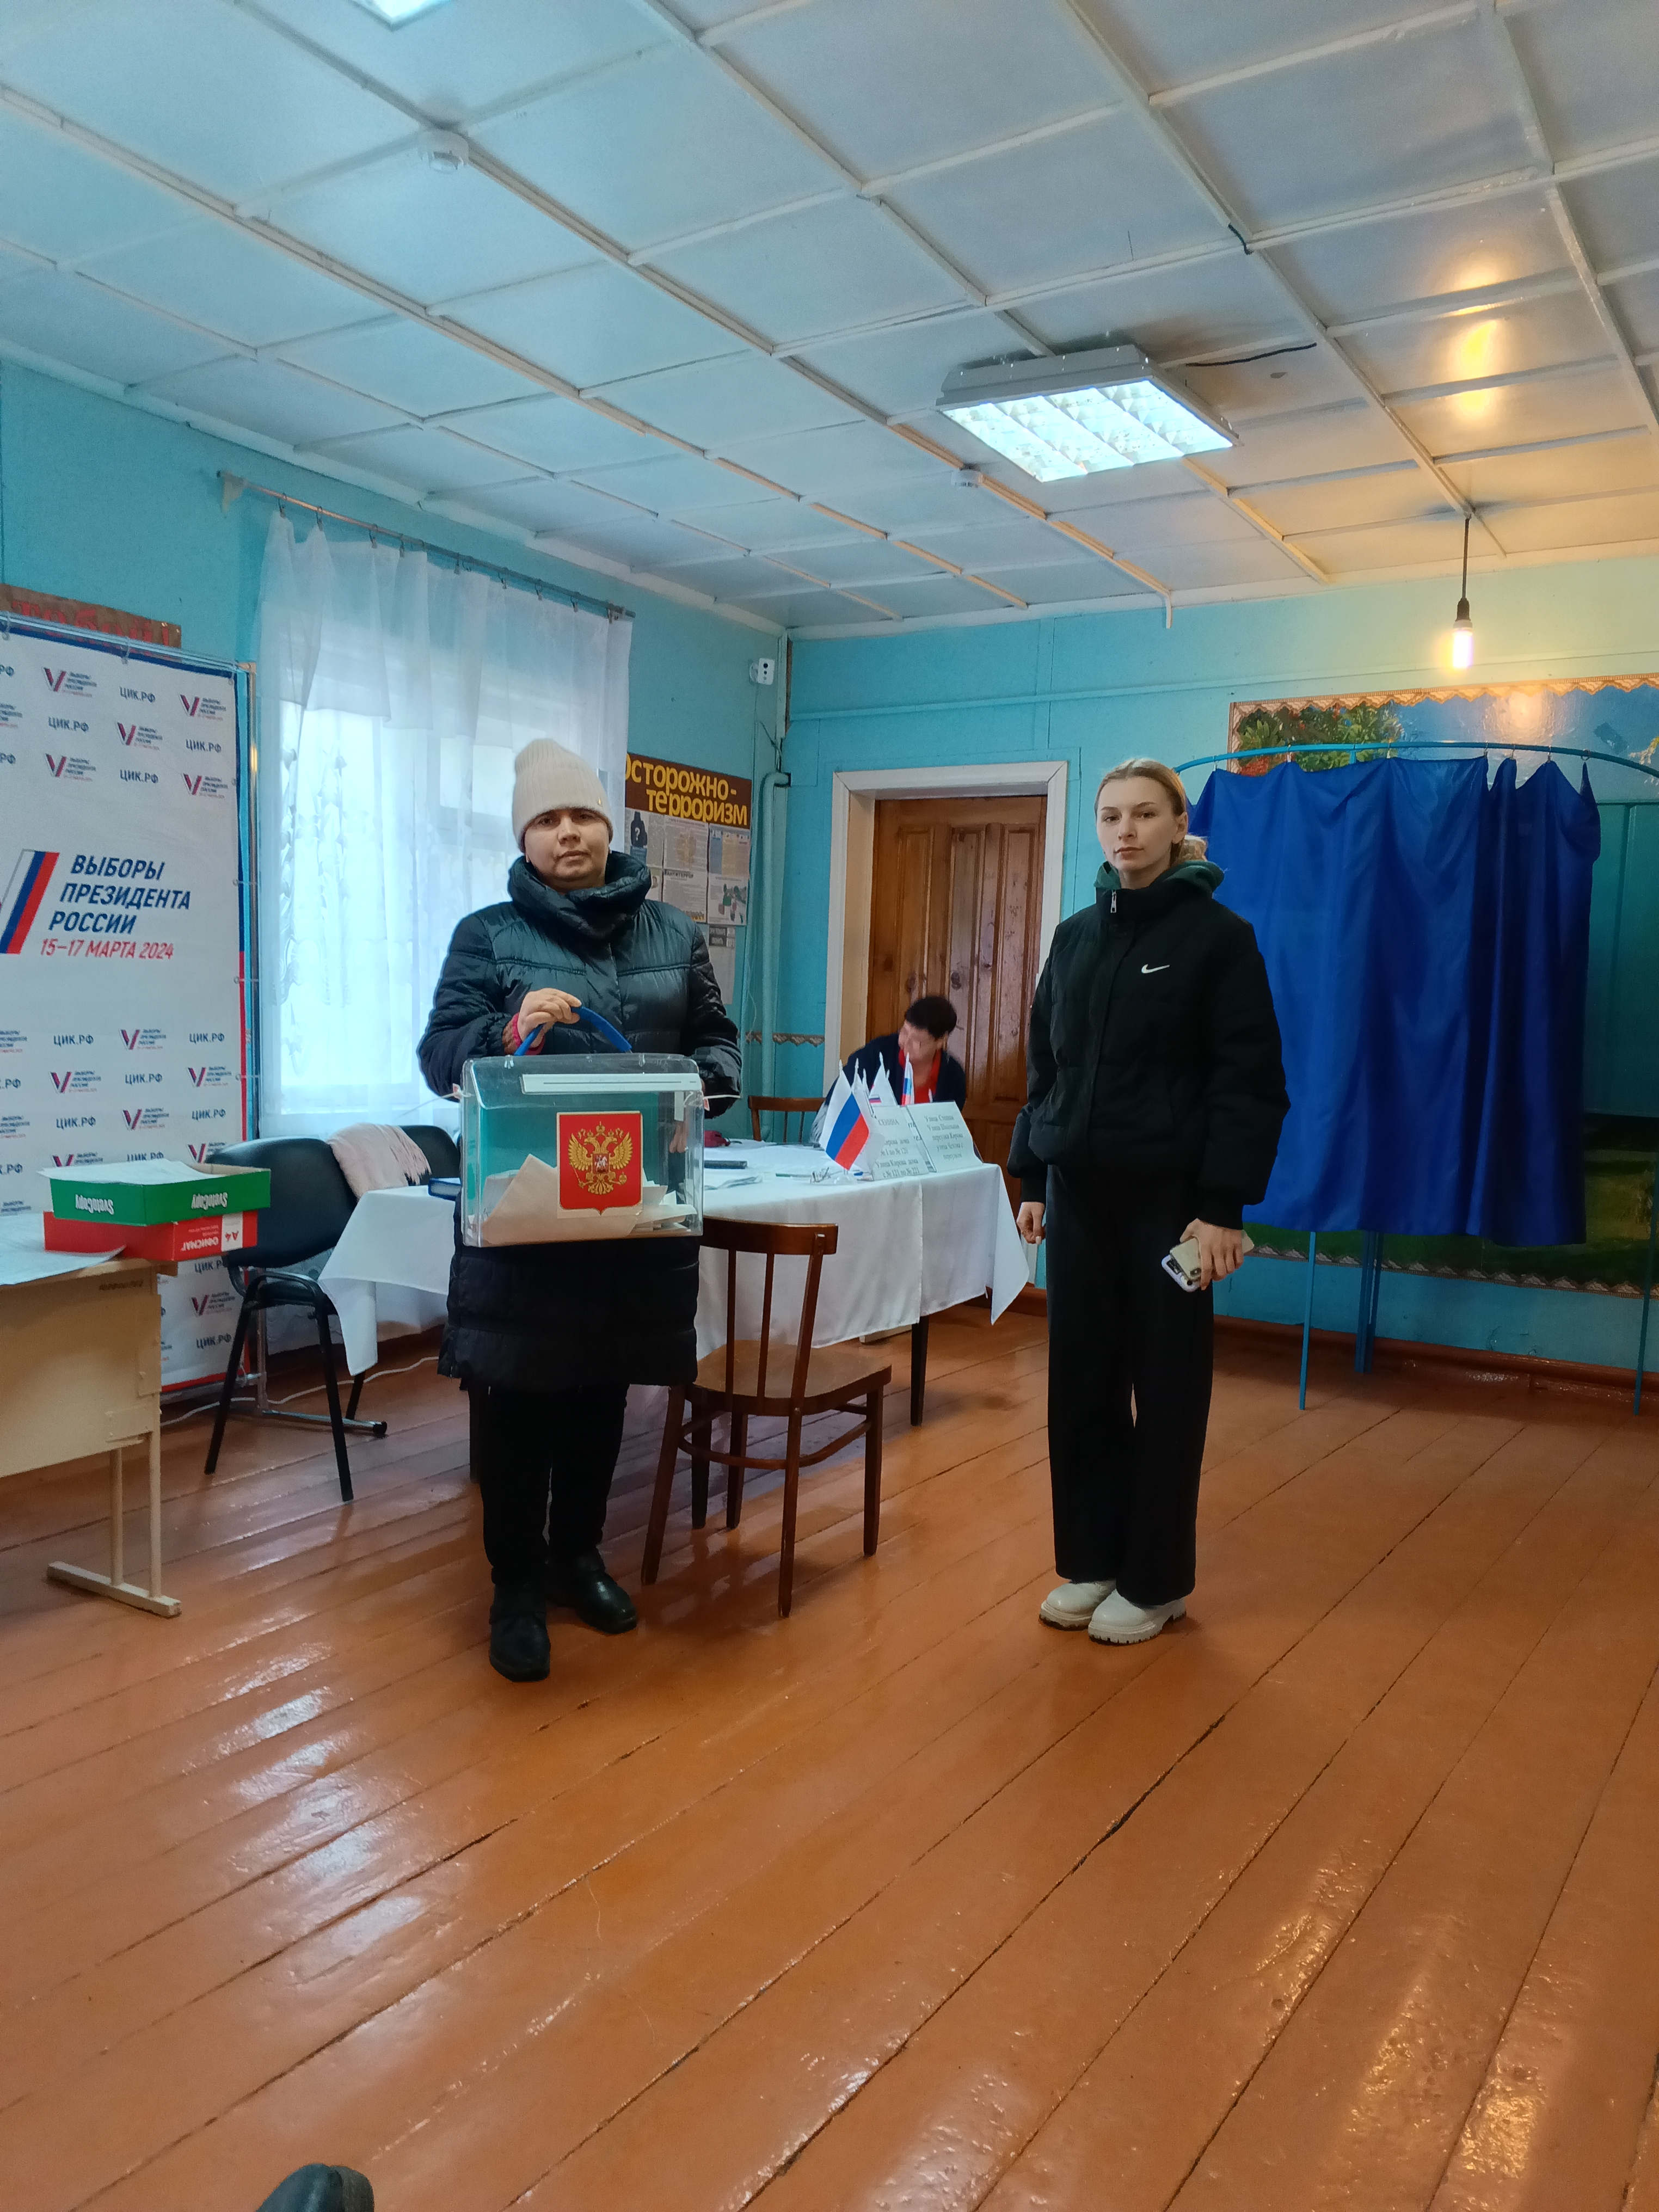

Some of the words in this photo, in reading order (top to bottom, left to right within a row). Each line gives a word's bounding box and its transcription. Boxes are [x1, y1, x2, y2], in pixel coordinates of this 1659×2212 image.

[120, 686, 156, 703] ЦИК.РФ
[48, 716, 89, 732] ЦИК.РФ
[186, 739, 222, 753] ЦИК.РФ
[120, 769, 158, 784] ЦИК.РФ
[646, 789, 747, 826] терроризм
[70, 854, 165, 881] ВЫБОРЫ
[59, 882, 191, 910] ПРЕЗИДЕНТА
[48, 911, 138, 935] РОССИИ
[85, 940, 137, 958] МАРТА
[139, 942, 175, 960] 2024
[53, 1034, 94, 1047] ЦИК.РФ
[189, 1032, 225, 1044] ЦИК.РФ
[125, 1073, 163, 1086] ЦИК.РФ
[191, 1108, 226, 1121] ЦИК.РФ
[56, 1116, 96, 1130] ЦИК.РФ
[127, 1151, 164, 1162] ЦИКРФ
[76, 1194, 114, 1215] SvetoCopy
[194, 1259, 223, 1274] ЦИК.Р
